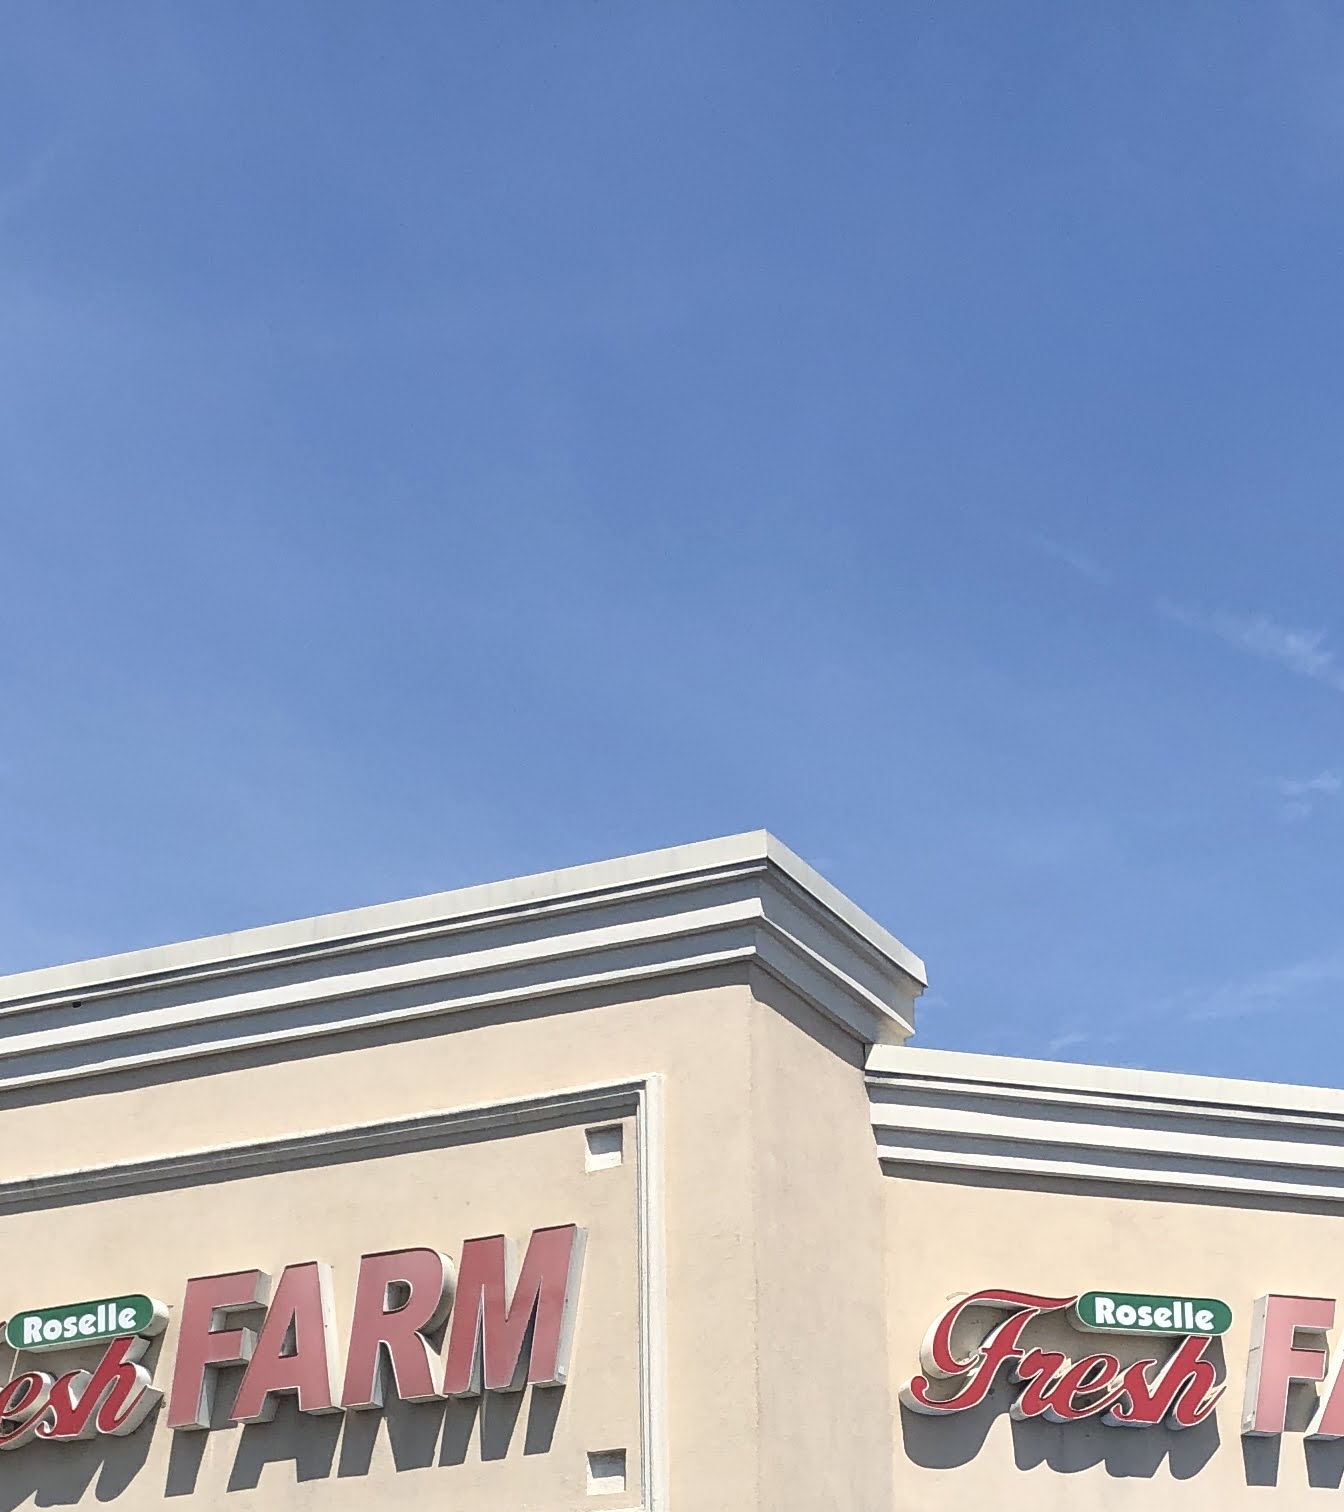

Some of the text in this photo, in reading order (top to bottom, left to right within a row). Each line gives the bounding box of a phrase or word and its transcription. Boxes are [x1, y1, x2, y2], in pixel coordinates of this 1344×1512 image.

[23, 1301, 137, 1345] Roselle
[168, 1223, 587, 1430] FARM
[909, 1288, 1227, 1430] Fresh
[1093, 1296, 1215, 1332] Roselle
